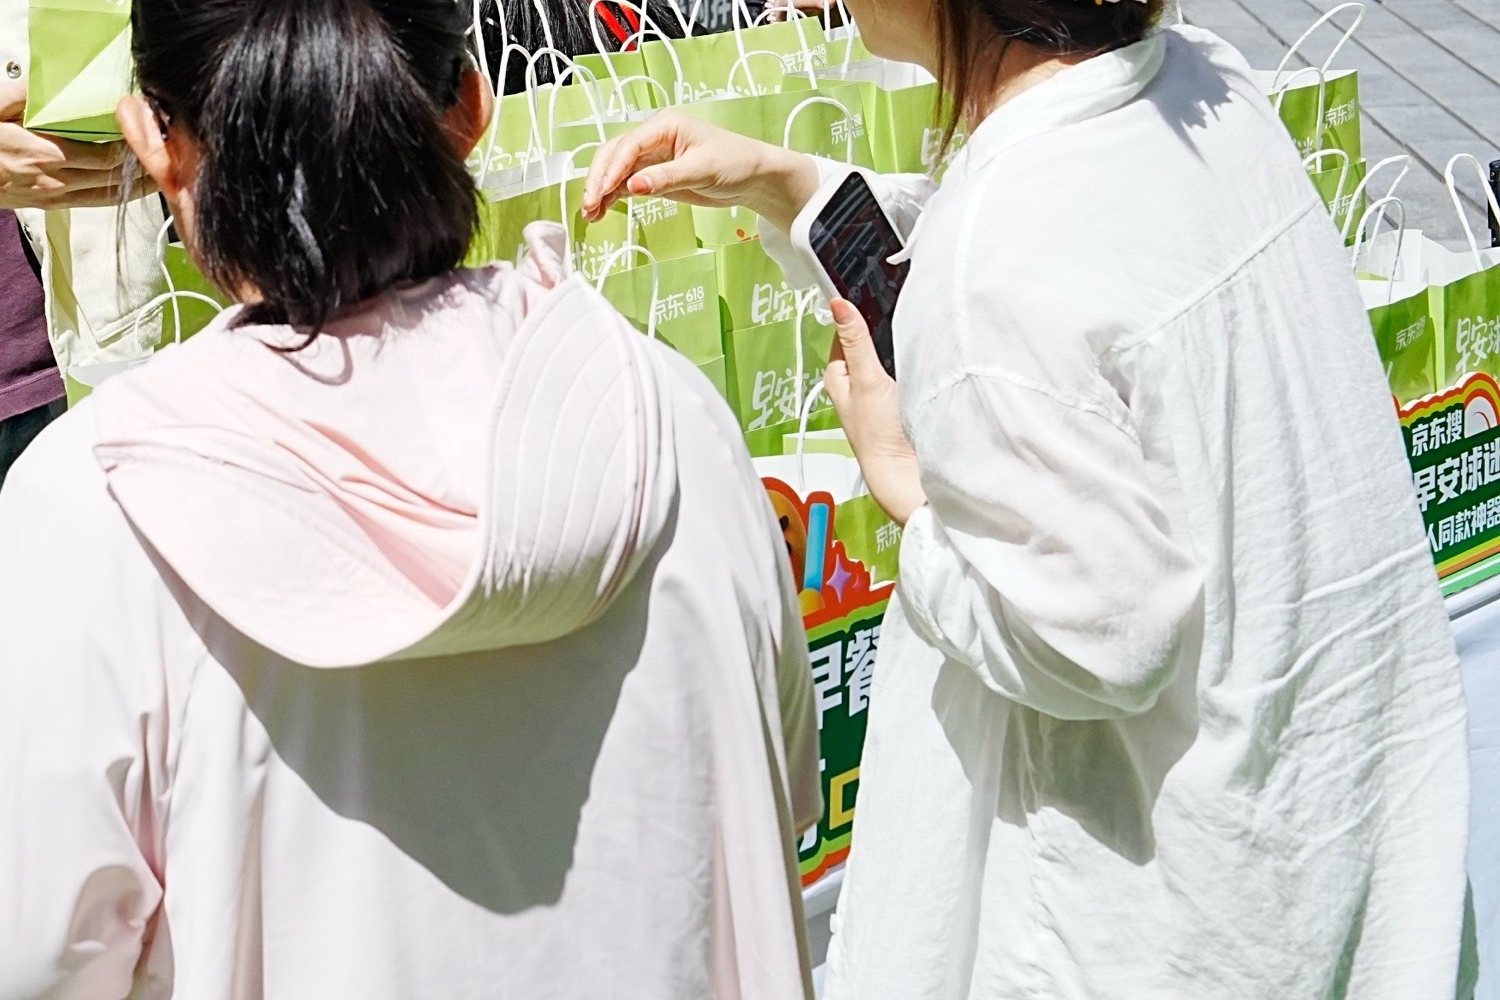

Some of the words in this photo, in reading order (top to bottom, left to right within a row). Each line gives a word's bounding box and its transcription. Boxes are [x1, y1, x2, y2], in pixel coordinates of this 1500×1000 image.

[1324, 103, 1348, 129] 京东
[654, 292, 686, 325] 京东
[685, 285, 705, 303] 618
[1395, 321, 1418, 352] 京东
[1411, 409, 1463, 457] 京东搜
[1413, 437, 1500, 512] 早安球迷
[875, 520, 902, 554] 京东
